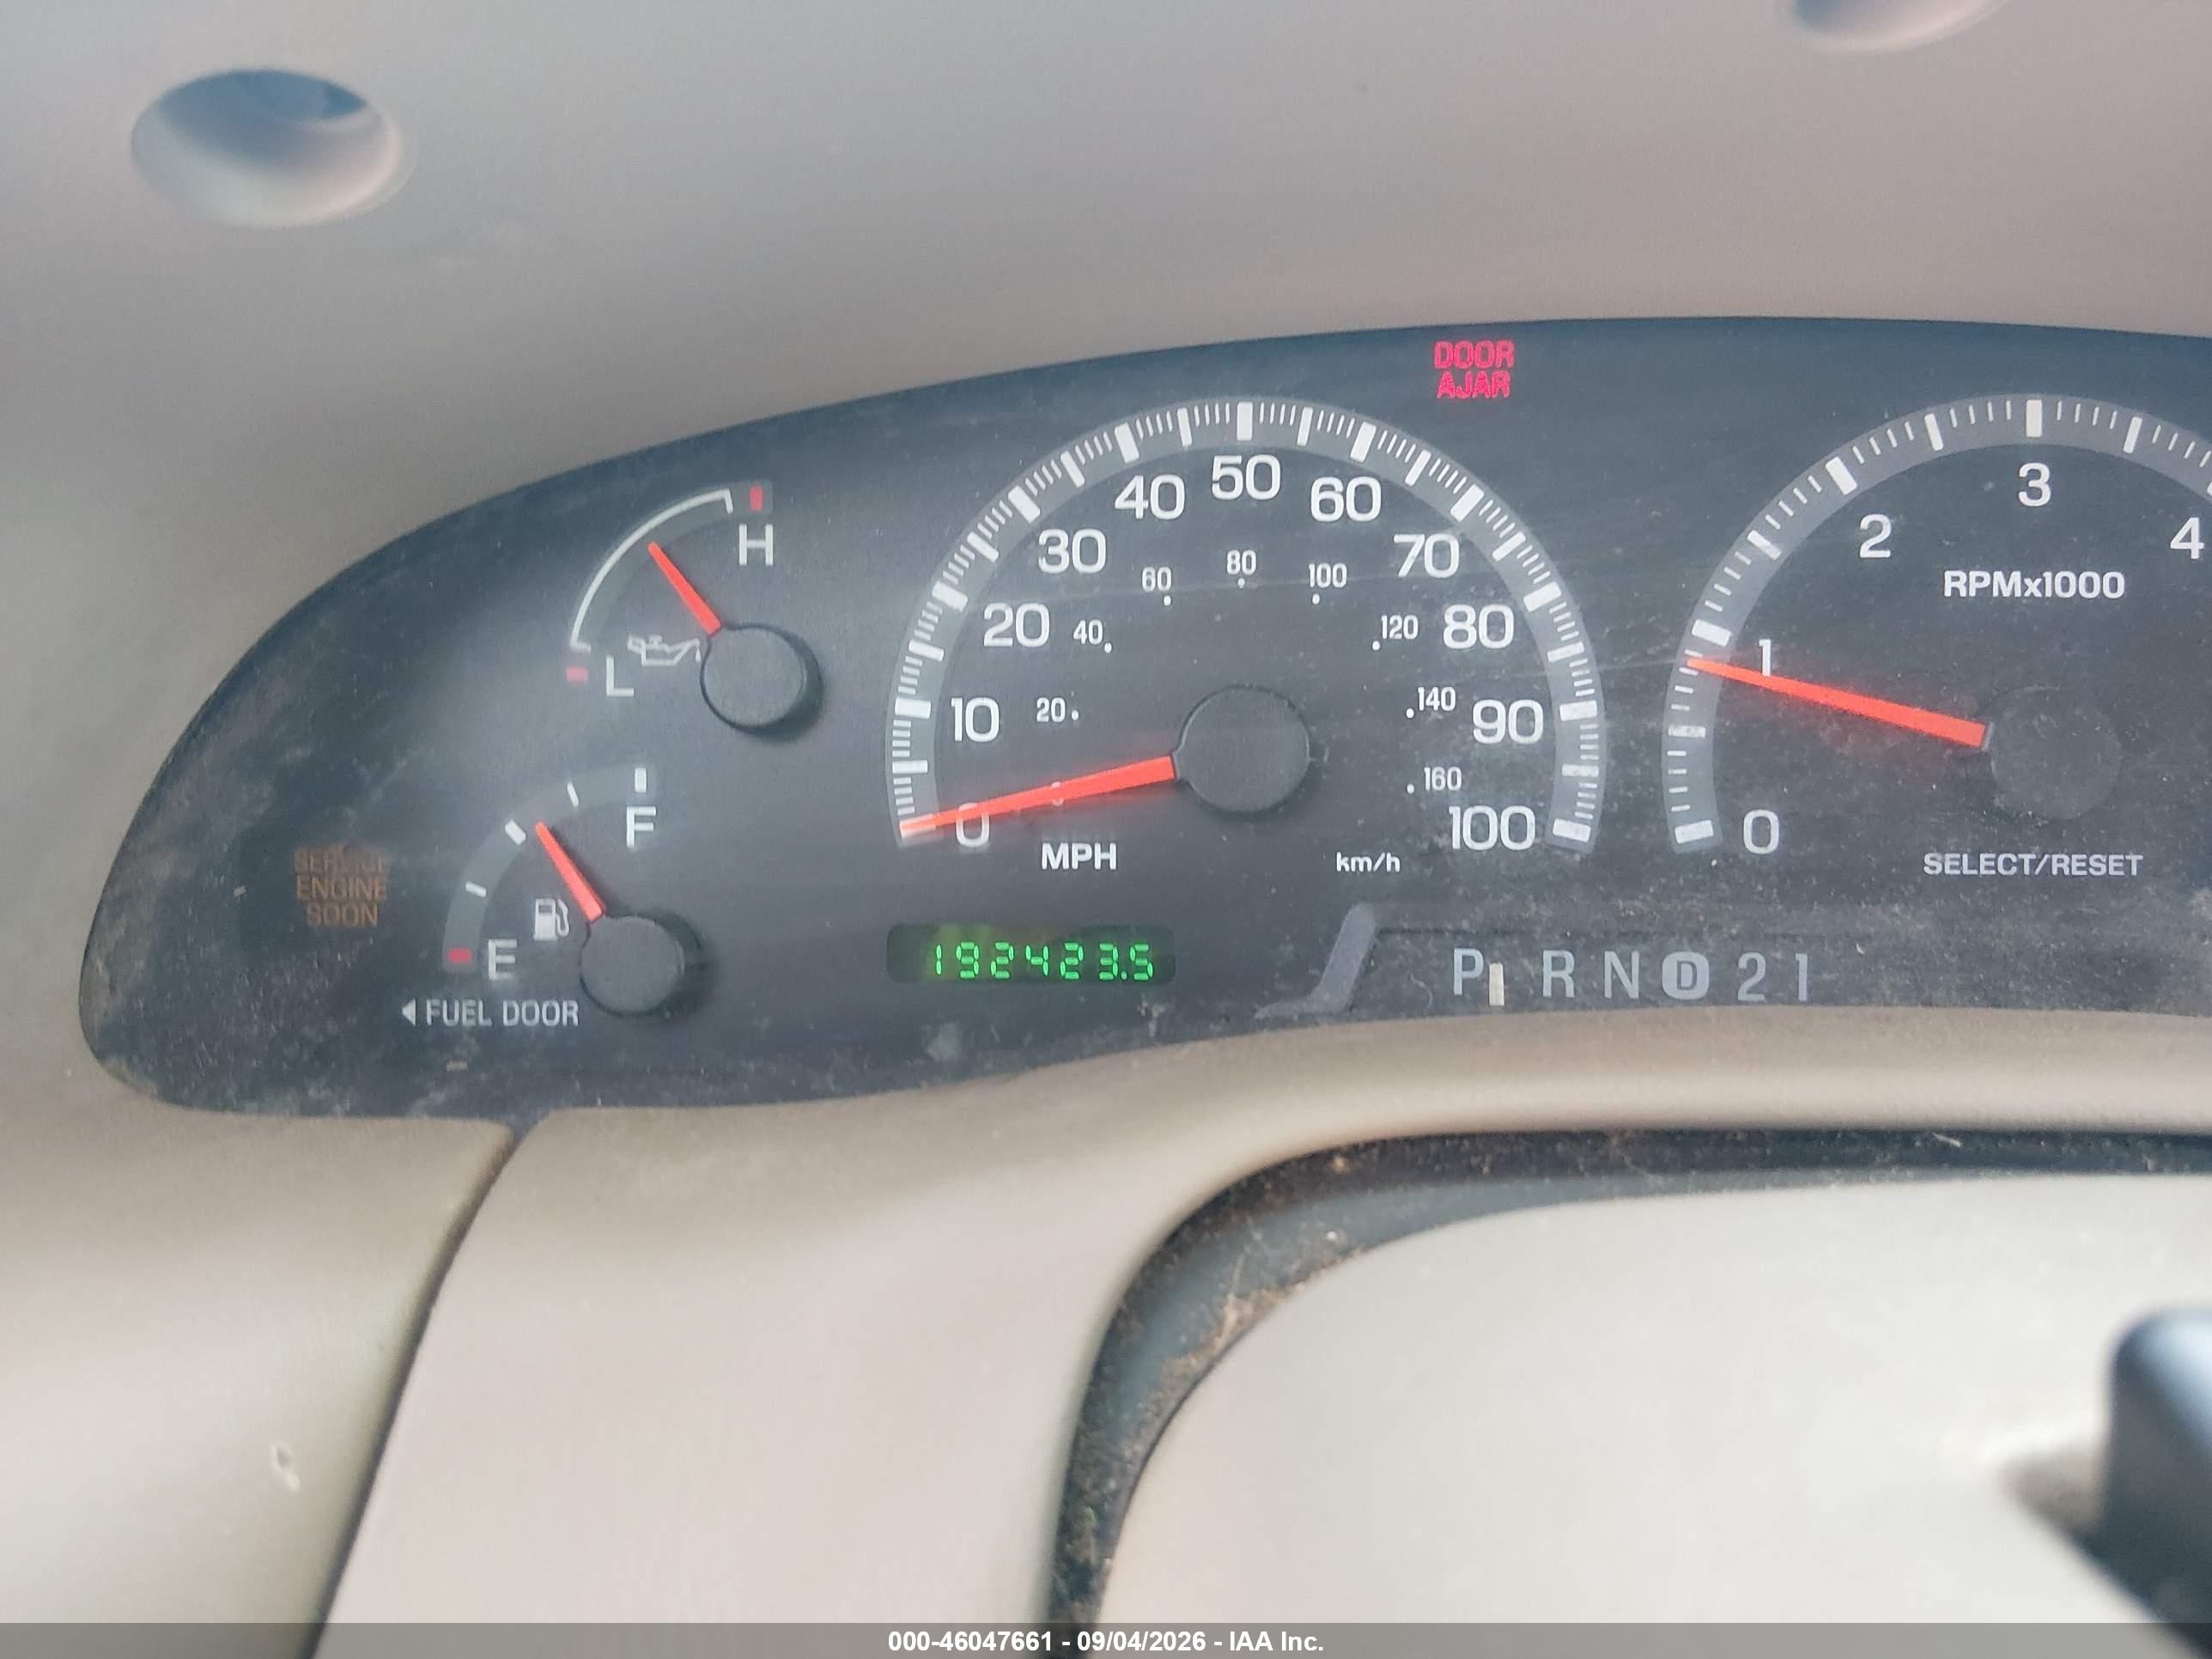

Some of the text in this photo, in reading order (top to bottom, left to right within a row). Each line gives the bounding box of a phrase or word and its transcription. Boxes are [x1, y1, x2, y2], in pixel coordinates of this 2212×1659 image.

[1434, 340, 1515, 369] DOOR
[1436, 370, 1510, 399] AJAR
[1115, 475, 1186, 520] 40
[1211, 455, 1282, 501] 50
[2019, 464, 2052, 508] 3
[1310, 477, 1382, 522] 60
[738, 523, 775, 567] H
[1036, 529, 1107, 574] 30
[1393, 534, 1461, 579] 70
[1858, 514, 1892, 559] 2
[2170, 517, 2205, 560] 4
[1140, 567, 1173, 592] 60
[1225, 550, 1257, 576] 80
[1308, 563, 1348, 589] 100
[1942, 569, 2126, 599] RPMx1000
[982, 604, 1051, 647] 20
[1073, 620, 1103, 646] 40
[1380, 616, 1419, 641] 120
[1442, 604, 1515, 650] 80
[605, 655, 635, 696] L
[1759, 639, 1772, 677] 1
[951, 698, 1000, 743] 10
[1036, 698, 1066, 723] 20
[1418, 688, 1456, 713] 140
[1472, 699, 1544, 745] 90
[1423, 767, 1462, 792] 160
[626, 805, 657, 848] F
[1449, 805, 1536, 851] 100
[1742, 808, 1781, 855] 0
[1041, 842, 1117, 871] MPH
[1335, 853, 1401, 874] km/h
[1923, 853, 2144, 877] SELECT/RESET
[296, 874, 387, 901] ENGINE
[307, 902, 379, 928] SOON
[488, 939, 517, 981] E
[934, 941, 1155, 981] 192423.5
[1453, 947, 1484, 996] P
[1542, 950, 1575, 998] R
[1603, 951, 1640, 999] N
[1737, 951, 1766, 1002] 2
[1795, 952, 1808, 1002] 1
[425, 1000, 580, 1027] FUEL DOOR
